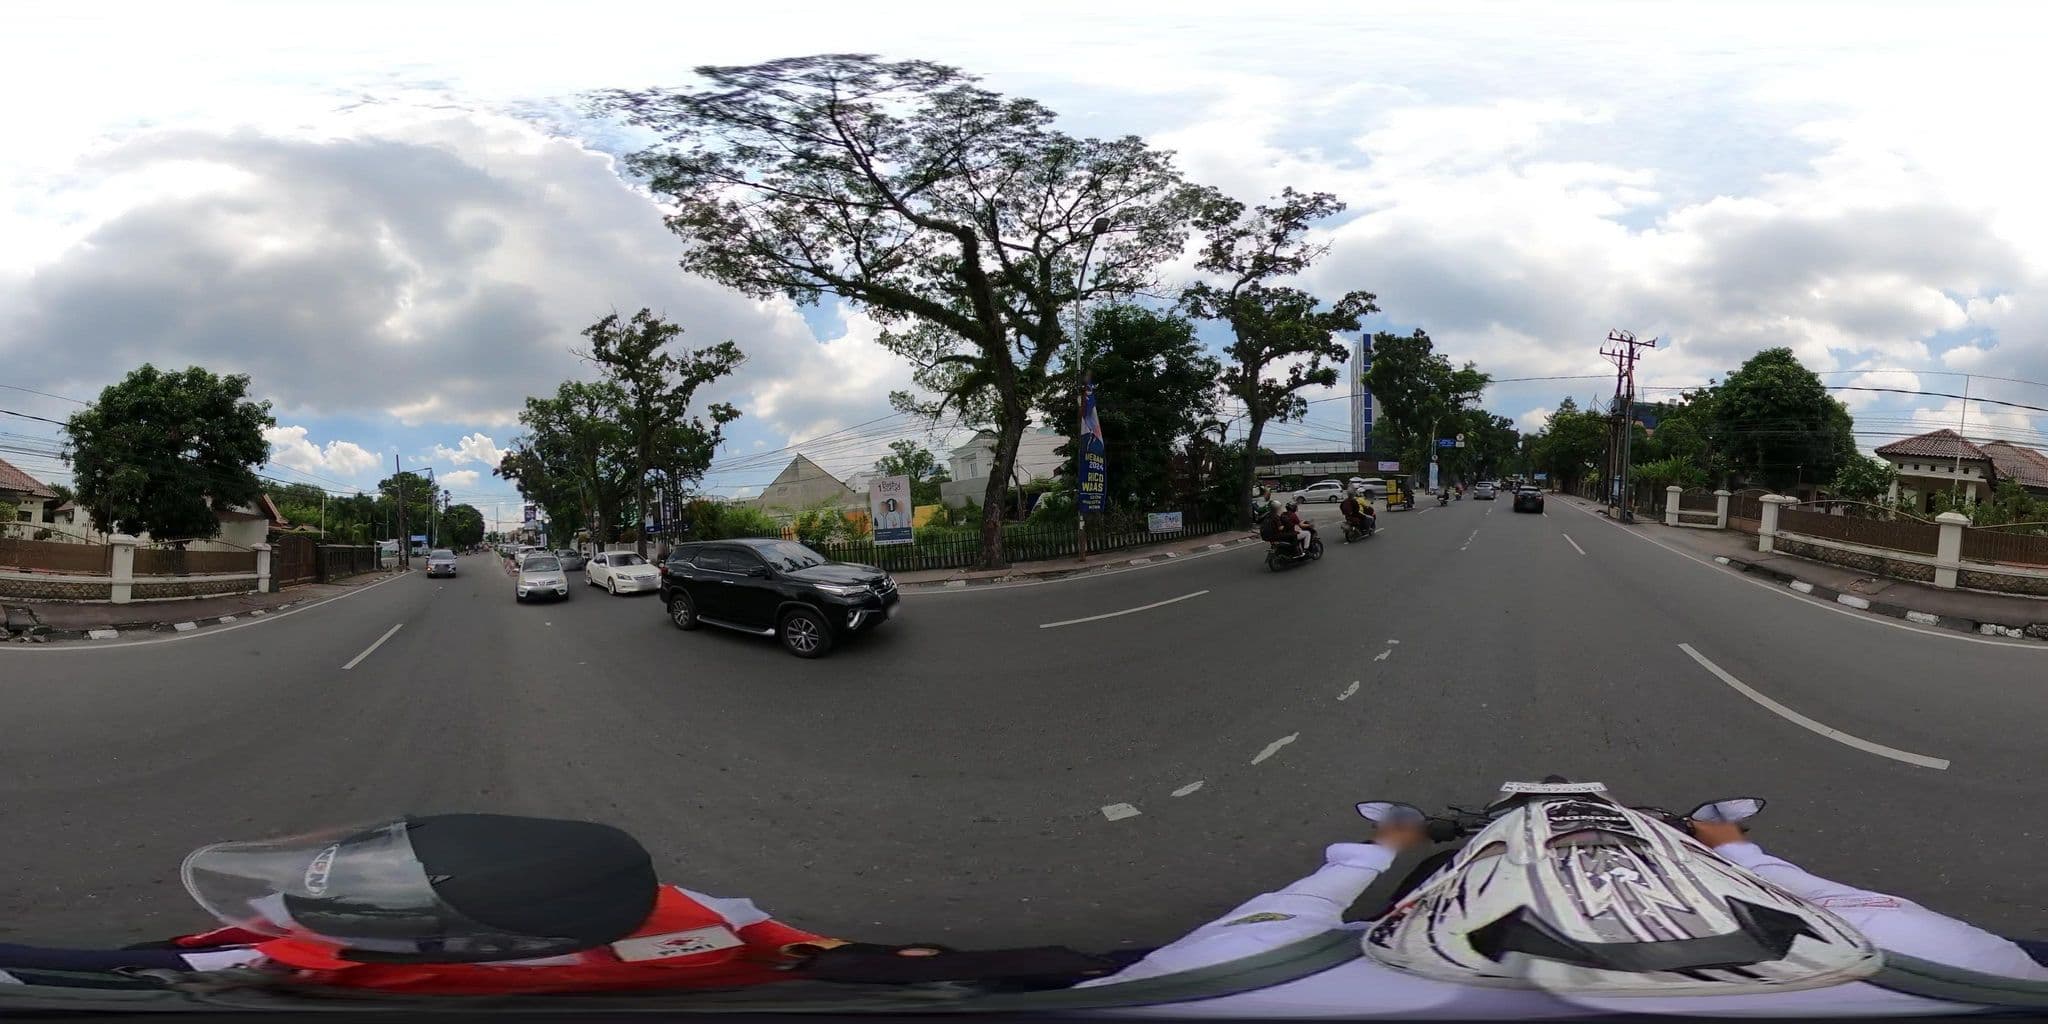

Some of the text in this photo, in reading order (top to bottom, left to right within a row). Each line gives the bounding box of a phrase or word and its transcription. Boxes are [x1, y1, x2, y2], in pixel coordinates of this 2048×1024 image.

[1089, 461, 1104, 471] 2024
[1087, 472, 1104, 482] RICO
[1081, 482, 1104, 492] WAAS
[657, 943, 715, 956] PMI
